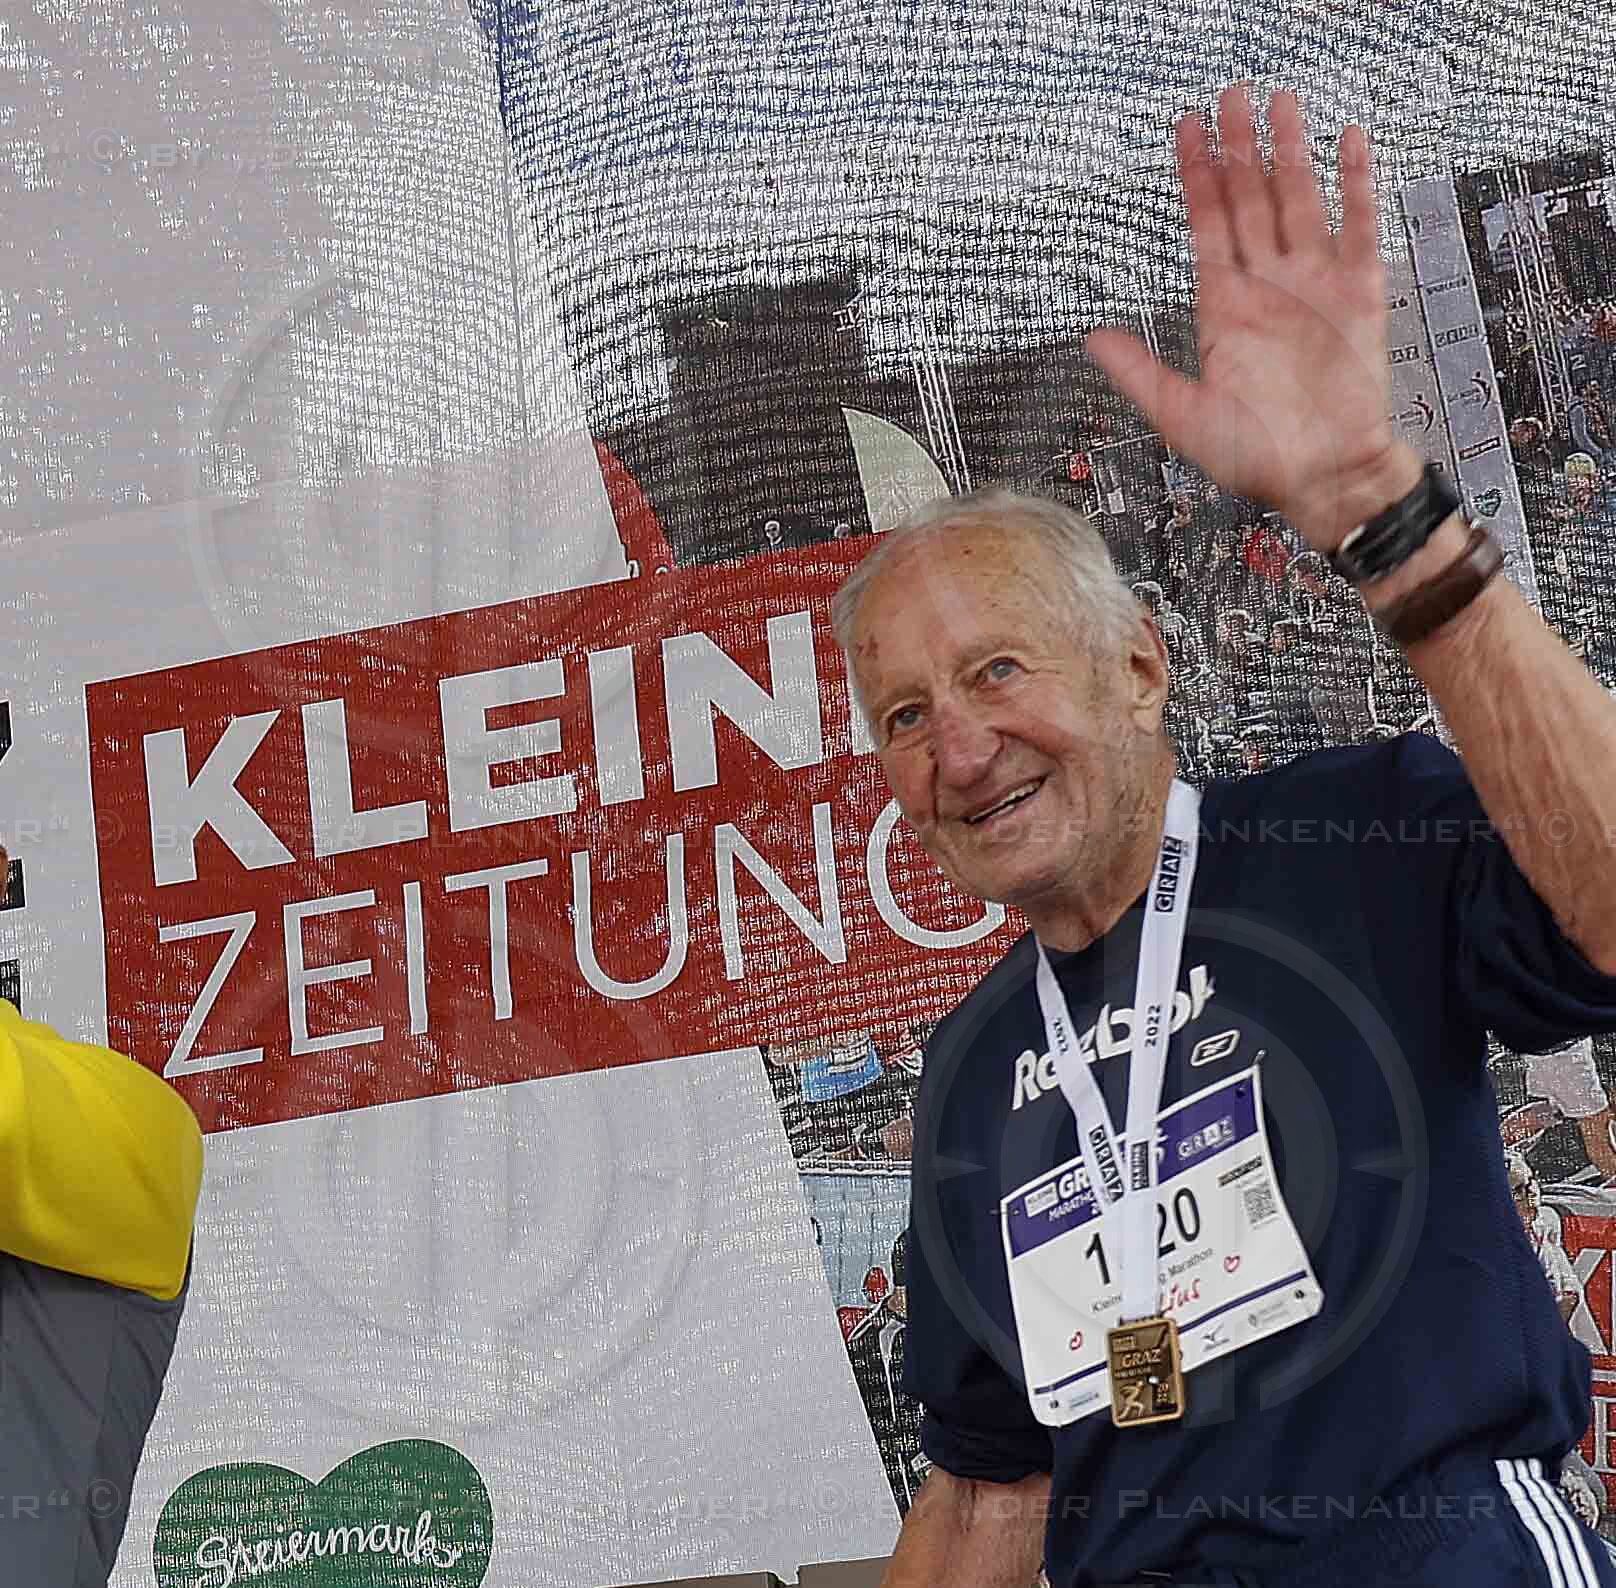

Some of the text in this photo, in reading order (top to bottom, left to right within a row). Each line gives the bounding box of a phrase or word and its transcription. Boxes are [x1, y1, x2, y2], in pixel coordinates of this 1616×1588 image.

[143, 611, 875, 887] KLEIN
[1144, 1003, 1162, 1048] 2022
[1084, 1187, 1201, 1286] 120
